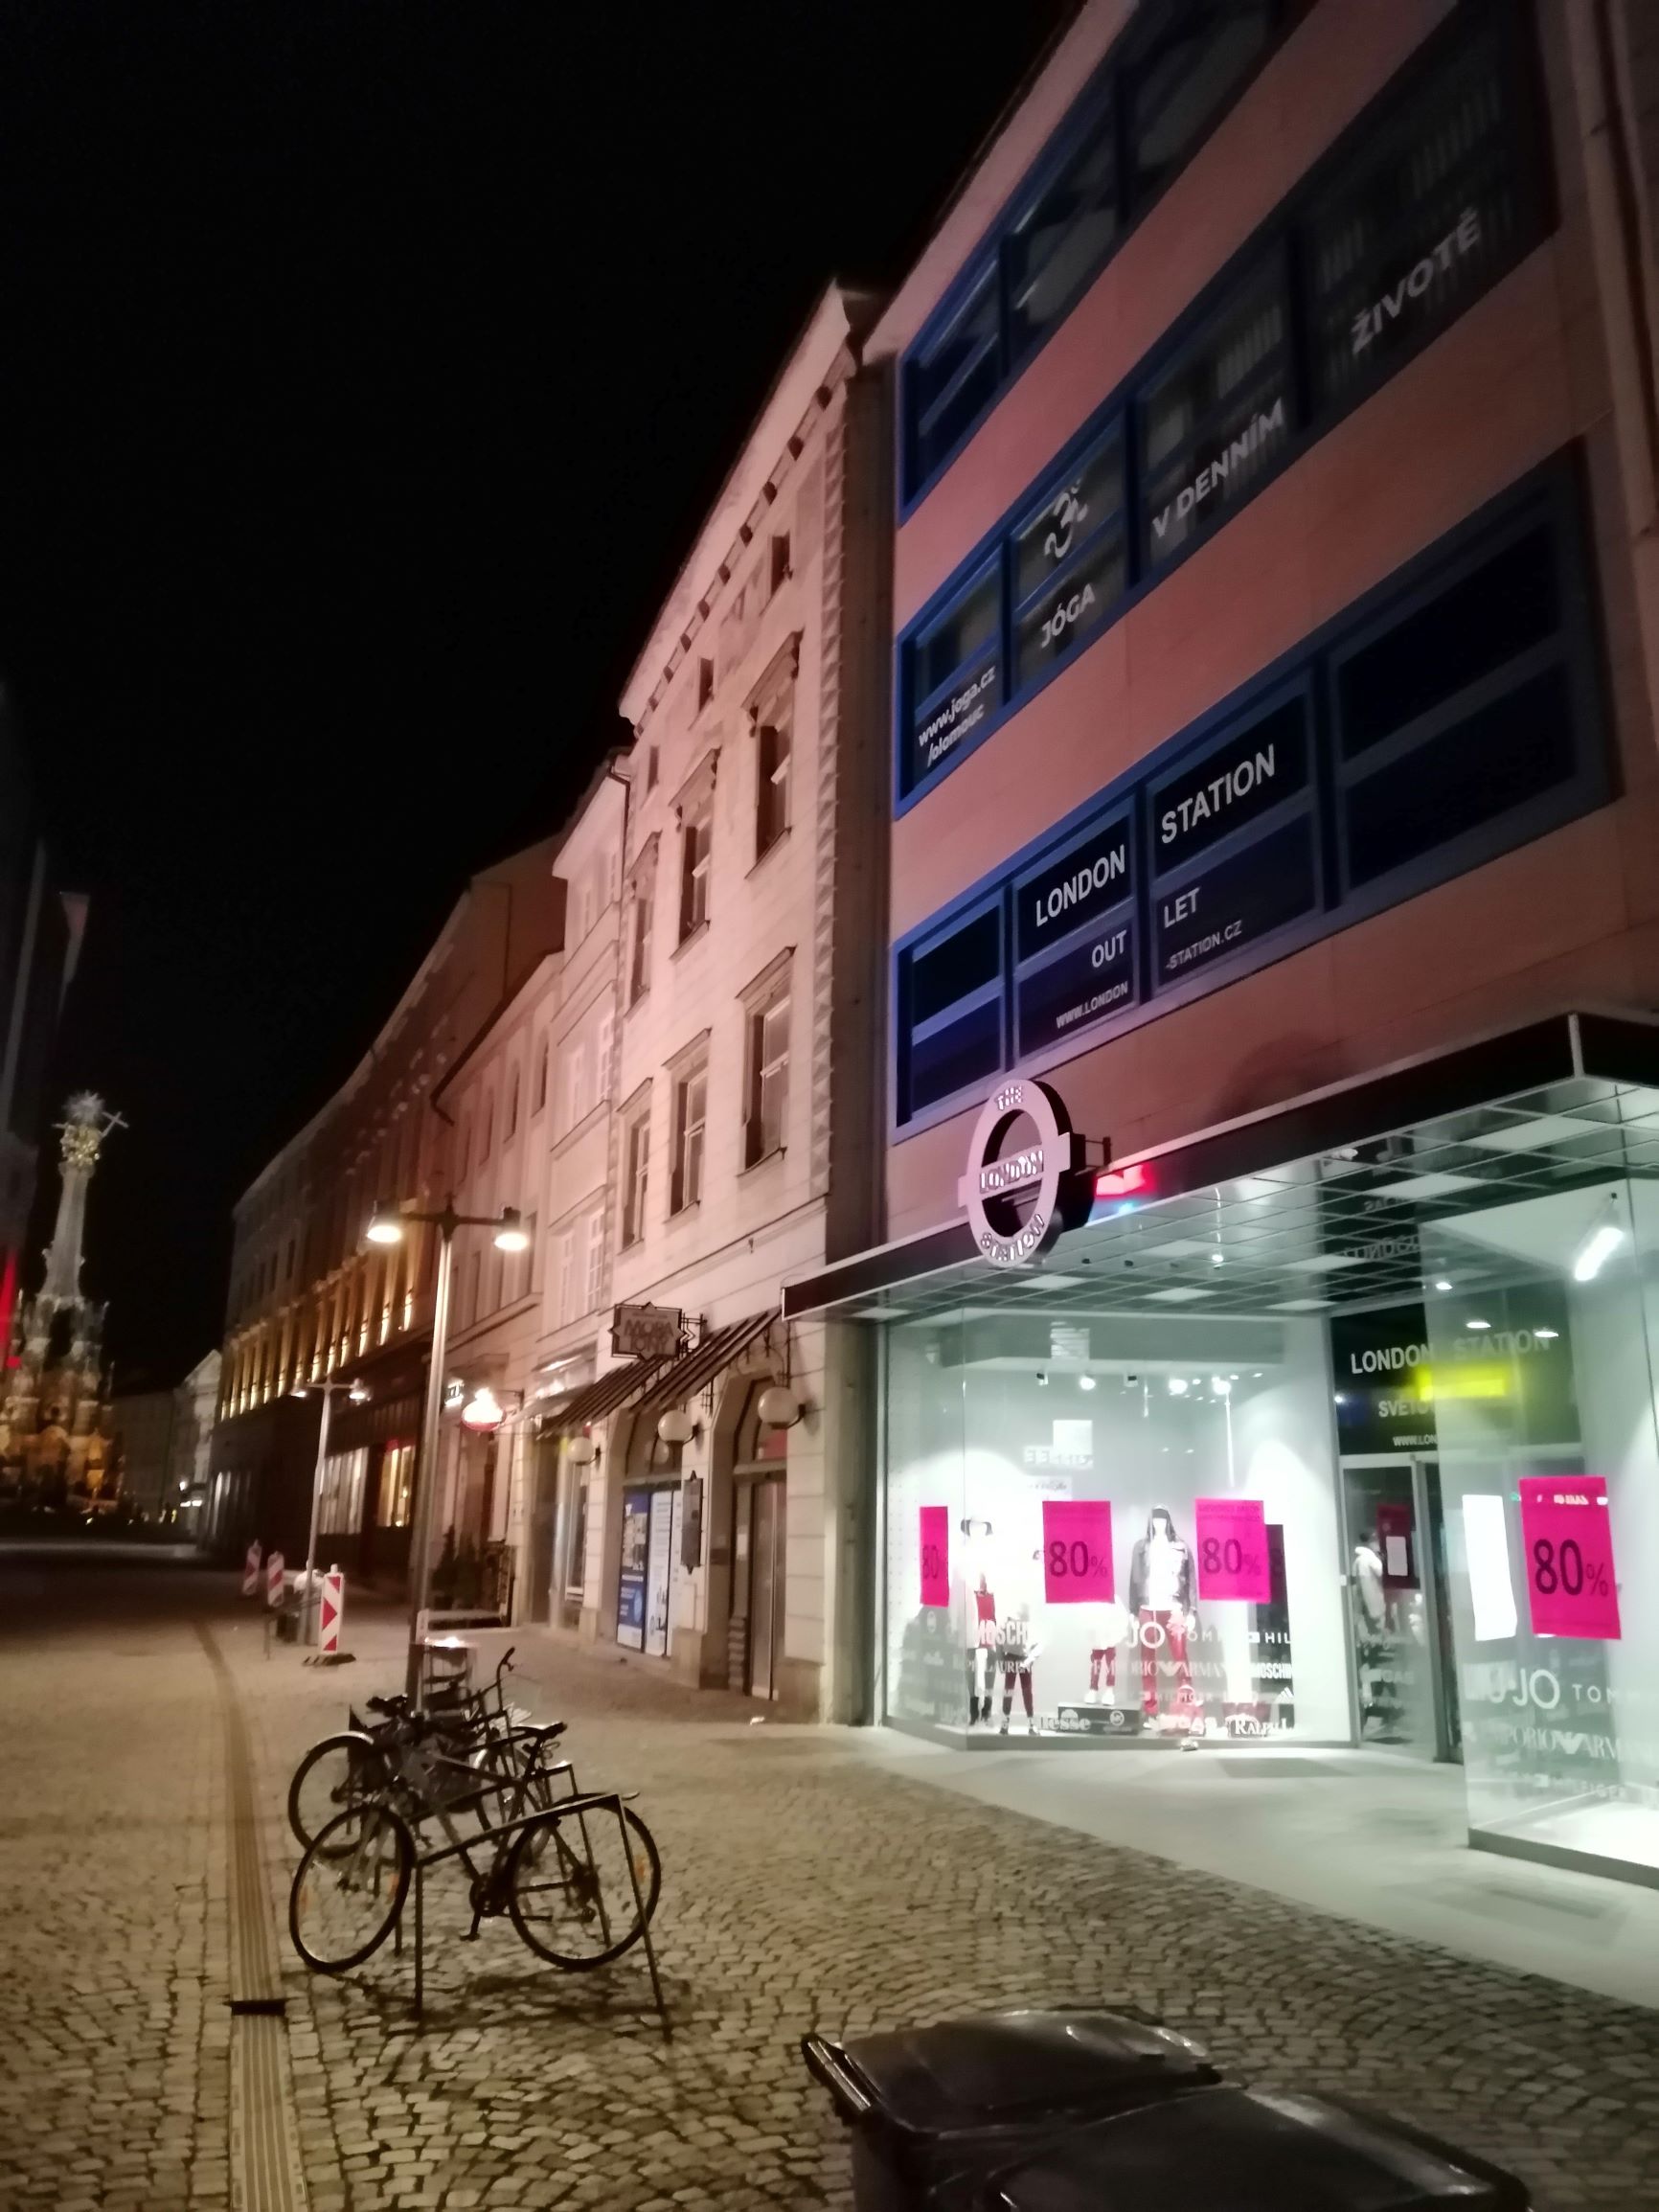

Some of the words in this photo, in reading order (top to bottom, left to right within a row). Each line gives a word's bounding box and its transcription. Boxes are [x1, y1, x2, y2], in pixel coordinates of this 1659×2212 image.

[1152, 505, 1170, 537] V
[1176, 397, 1284, 520] DENNÍM
[1351, 206, 1481, 355] ŽIVOTĚ
[1041, 582, 1096, 649] JÓGA
[919, 666, 997, 747] www.joga.cz
[1035, 845, 1125, 927] LONDON
[1160, 743, 1276, 845] STATION
[1092, 929, 1127, 969] OUT
[1164, 886, 1201, 929] LET
[1056, 980, 1128, 1029] WWW.LONDON
[980, 1150, 1044, 1195] LONDON
[1351, 1343, 1434, 1375] LONDON
[1453, 1329, 1551, 1361] STATION
[1049, 1540, 1108, 1578] 80%
[1202, 1537, 1261, 1577] 80%
[1534, 1539, 1609, 1596] 80%
